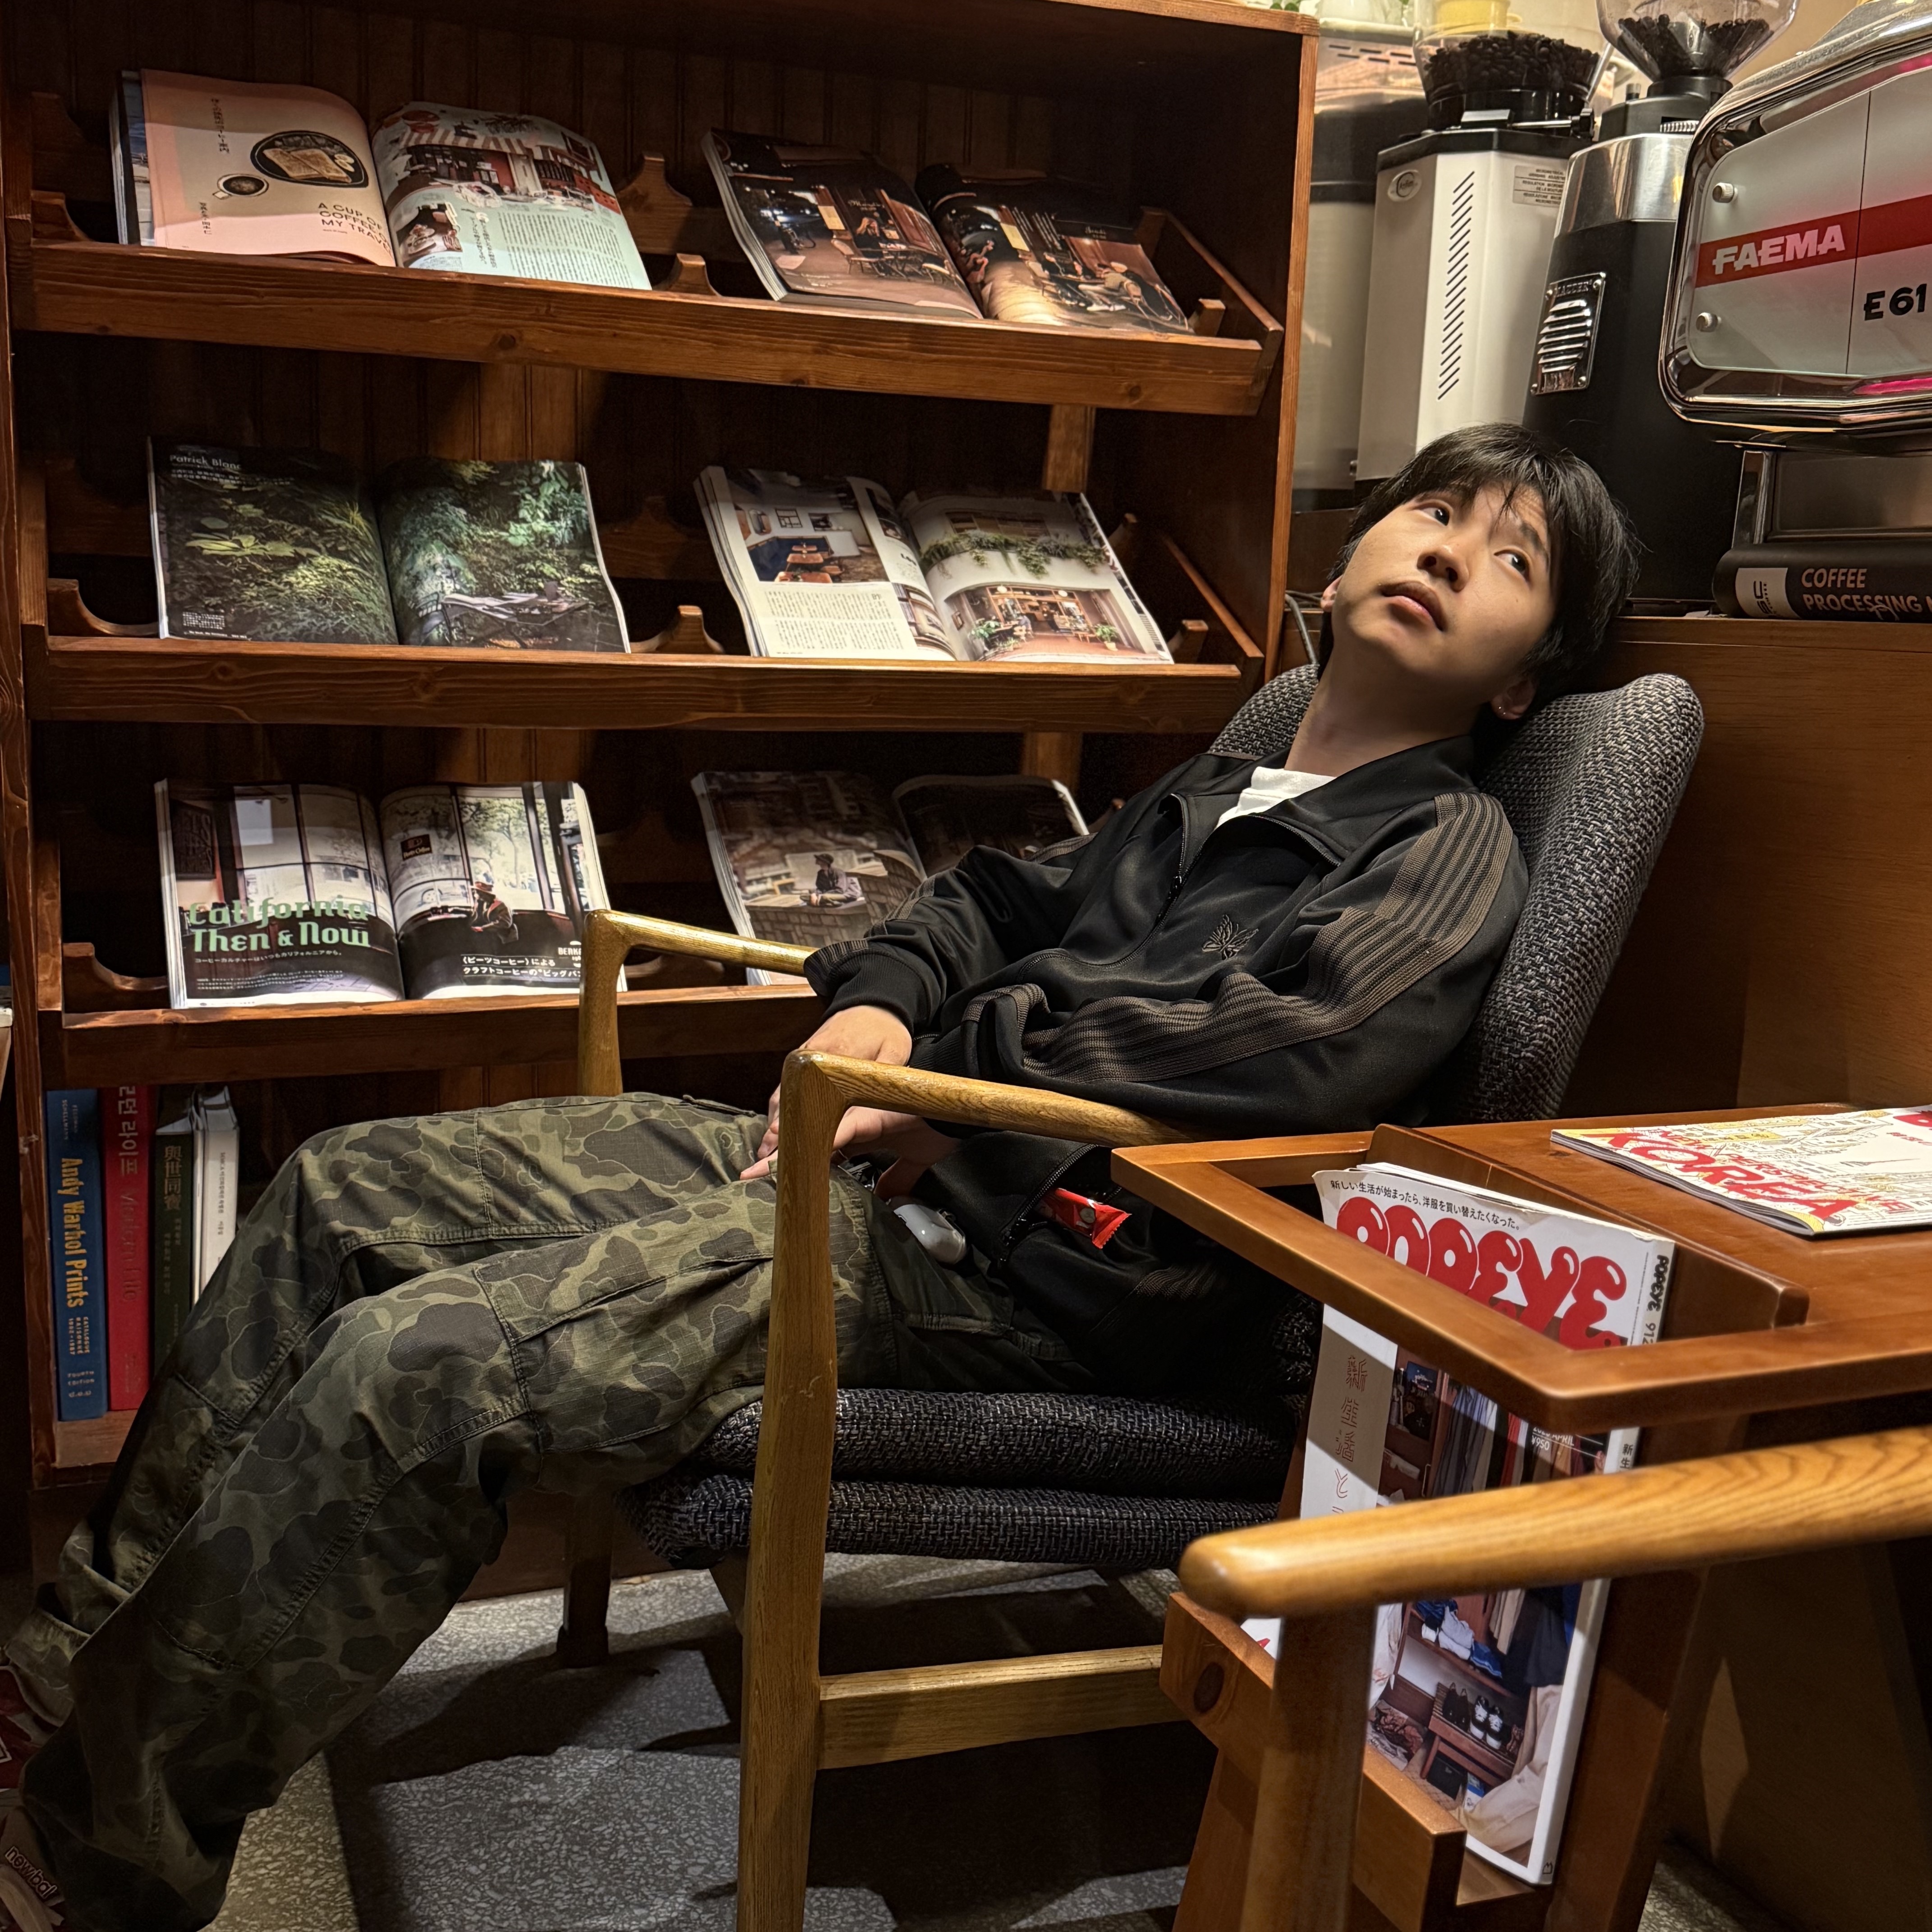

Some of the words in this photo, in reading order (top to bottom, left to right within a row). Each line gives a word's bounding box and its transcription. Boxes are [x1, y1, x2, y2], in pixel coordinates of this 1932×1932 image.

[319, 211, 376, 234] COFFEE
[333, 205, 362, 216] CUP
[1712, 225, 1845, 275] FAEMA
[170, 454, 207, 465] Patrick
[212, 458, 242, 469] Blanc
[1801, 568, 1867, 588] COFFEE
[1803, 594, 1923, 613] PROCESSING
[189, 895, 368, 929] California
[193, 928, 270, 952] Then
[278, 930, 294, 946] &
[299, 921, 371, 947] Now
[118, 1121, 139, 1177] 라이프
[57, 1158, 84, 1195] Andy
[1580, 1132, 1860, 1220] KOREA
[1330, 1180, 1520, 1230] 新しい生活が始まったら、洋服を買い替えたくなった。
[63, 1200, 87, 1255] Warhol
[65, 1259, 89, 1308] Prints
[1647, 1254, 1670, 1312] POPEYE
[1532, 1434, 1550, 1450] ¥950
